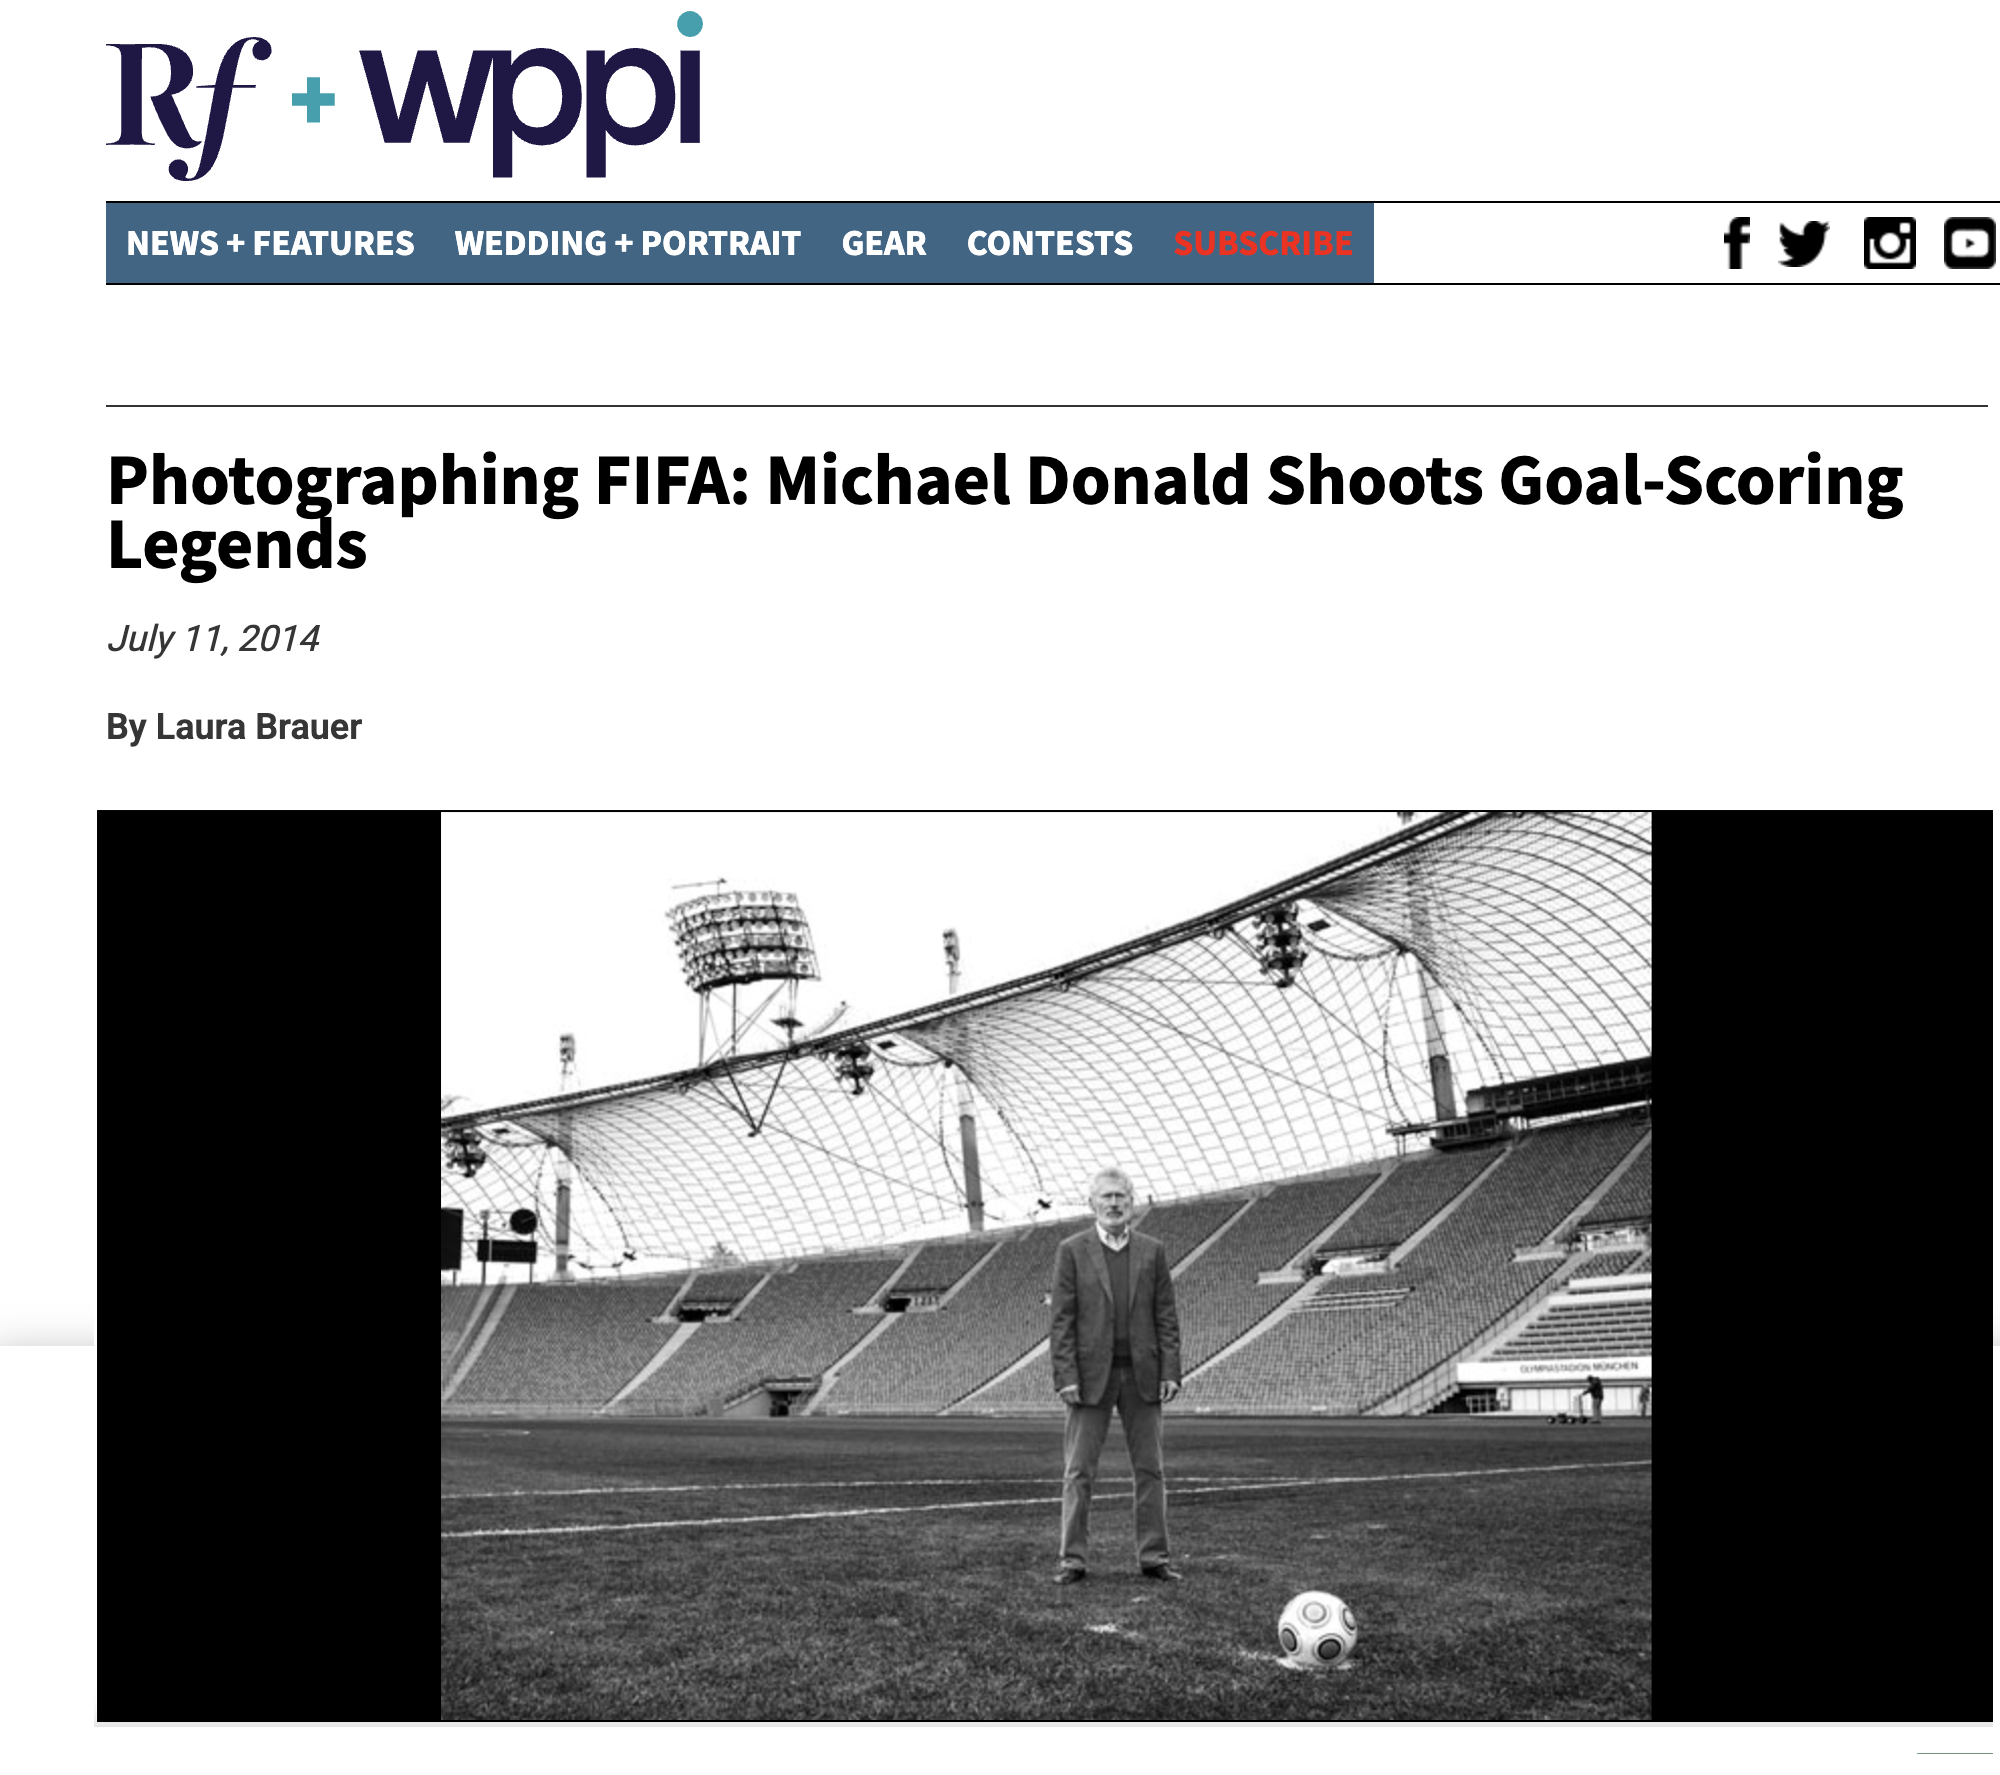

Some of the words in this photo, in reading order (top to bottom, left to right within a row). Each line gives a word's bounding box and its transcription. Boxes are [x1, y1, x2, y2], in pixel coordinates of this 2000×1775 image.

[106, 37, 272, 182] Rf
[359, 10, 704, 178] wppi
[127, 230, 219, 257] NEWS
[227, 233, 245, 253] +
[254, 230, 415, 257] FEATURES
[454, 230, 606, 257] WEDDING
[615, 233, 633, 253] +
[643, 230, 802, 257] PORTRAIT
[842, 230, 927, 257] GEAR
[967, 230, 1133, 257] CONTESTS
[1175, 230, 1353, 257] SUBSCRIBE
[110, 450, 579, 519] Photographing
[598, 455, 748, 506] FIFA:
[770, 450, 1011, 506] Michael
[1030, 452, 1248, 506] Donald
[1267, 452, 1483, 506] Shoots
[1500, 450, 1904, 519] Goal-Scoring
[110, 516, 367, 584] Legends
[107, 623, 177, 659] July
[187, 624, 228, 657] 11,
[238, 624, 321, 652] 2014
[107, 712, 147, 747] By
[157, 712, 246, 740] Laura
[257, 712, 363, 740] Brauer
